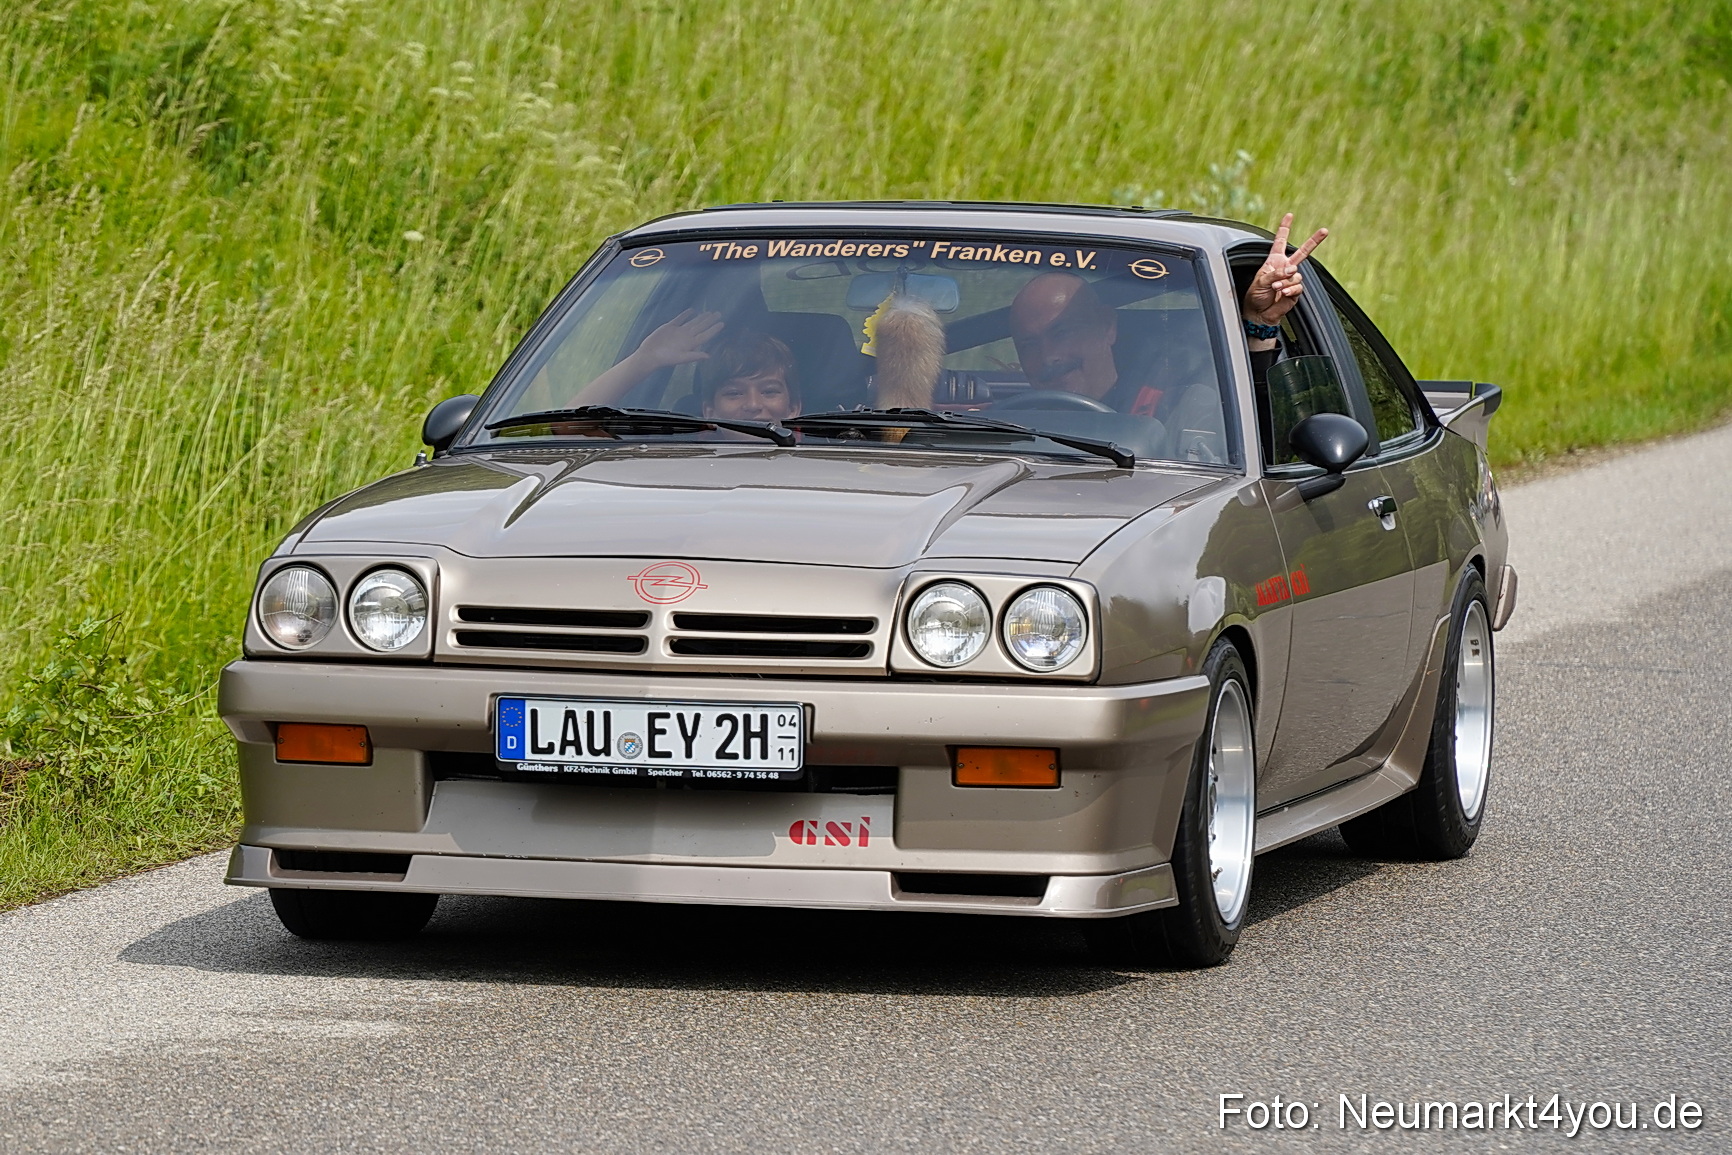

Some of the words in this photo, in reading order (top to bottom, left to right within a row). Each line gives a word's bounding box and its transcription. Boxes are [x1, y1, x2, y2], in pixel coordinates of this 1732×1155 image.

[699, 242, 759, 261] "The
[767, 239, 926, 259] Wanderers"
[930, 241, 1043, 266] Franken
[1049, 249, 1097, 271] e.V.
[777, 714, 797, 728] 04
[507, 736, 517, 749] D
[530, 708, 612, 757] LAU
[647, 711, 702, 759] EY
[715, 713, 769, 761] 2H
[777, 747, 796, 762] 11
[516, 762, 559, 773] Günthers
[563, 764, 611, 774] KFZ-Technik
[611, 767, 638, 776] GmbH
[647, 768, 684, 777] Speicher
[691, 769, 706, 778] Tel.
[743, 771, 755, 779] 74
[767, 771, 780, 780] 48
